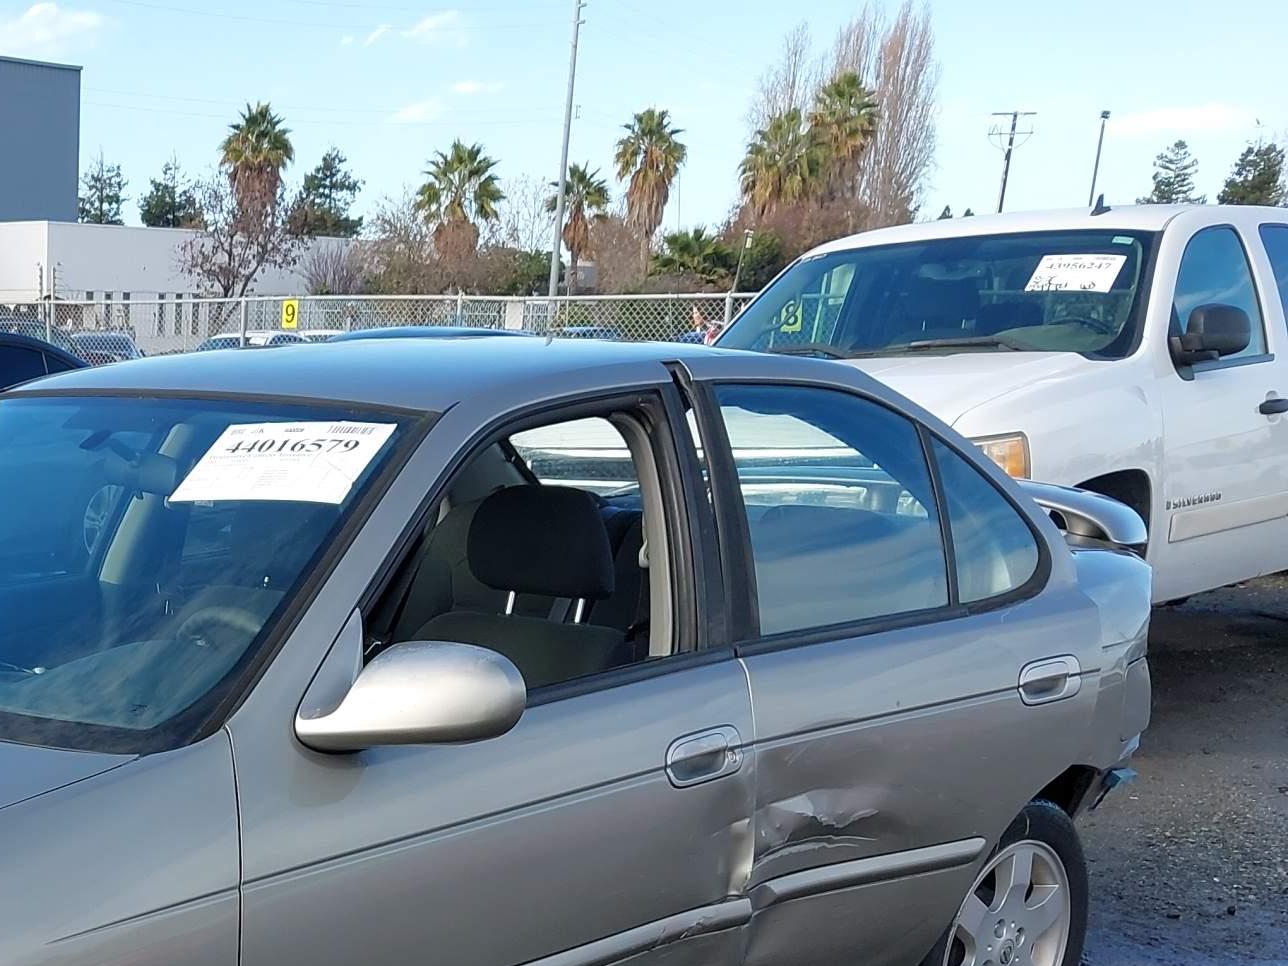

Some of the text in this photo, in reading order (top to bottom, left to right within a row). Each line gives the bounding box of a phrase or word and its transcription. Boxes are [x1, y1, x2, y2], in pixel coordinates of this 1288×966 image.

[285, 303, 296, 324] 9
[784, 303, 799, 327] 8
[225, 439, 360, 453] 44016579
